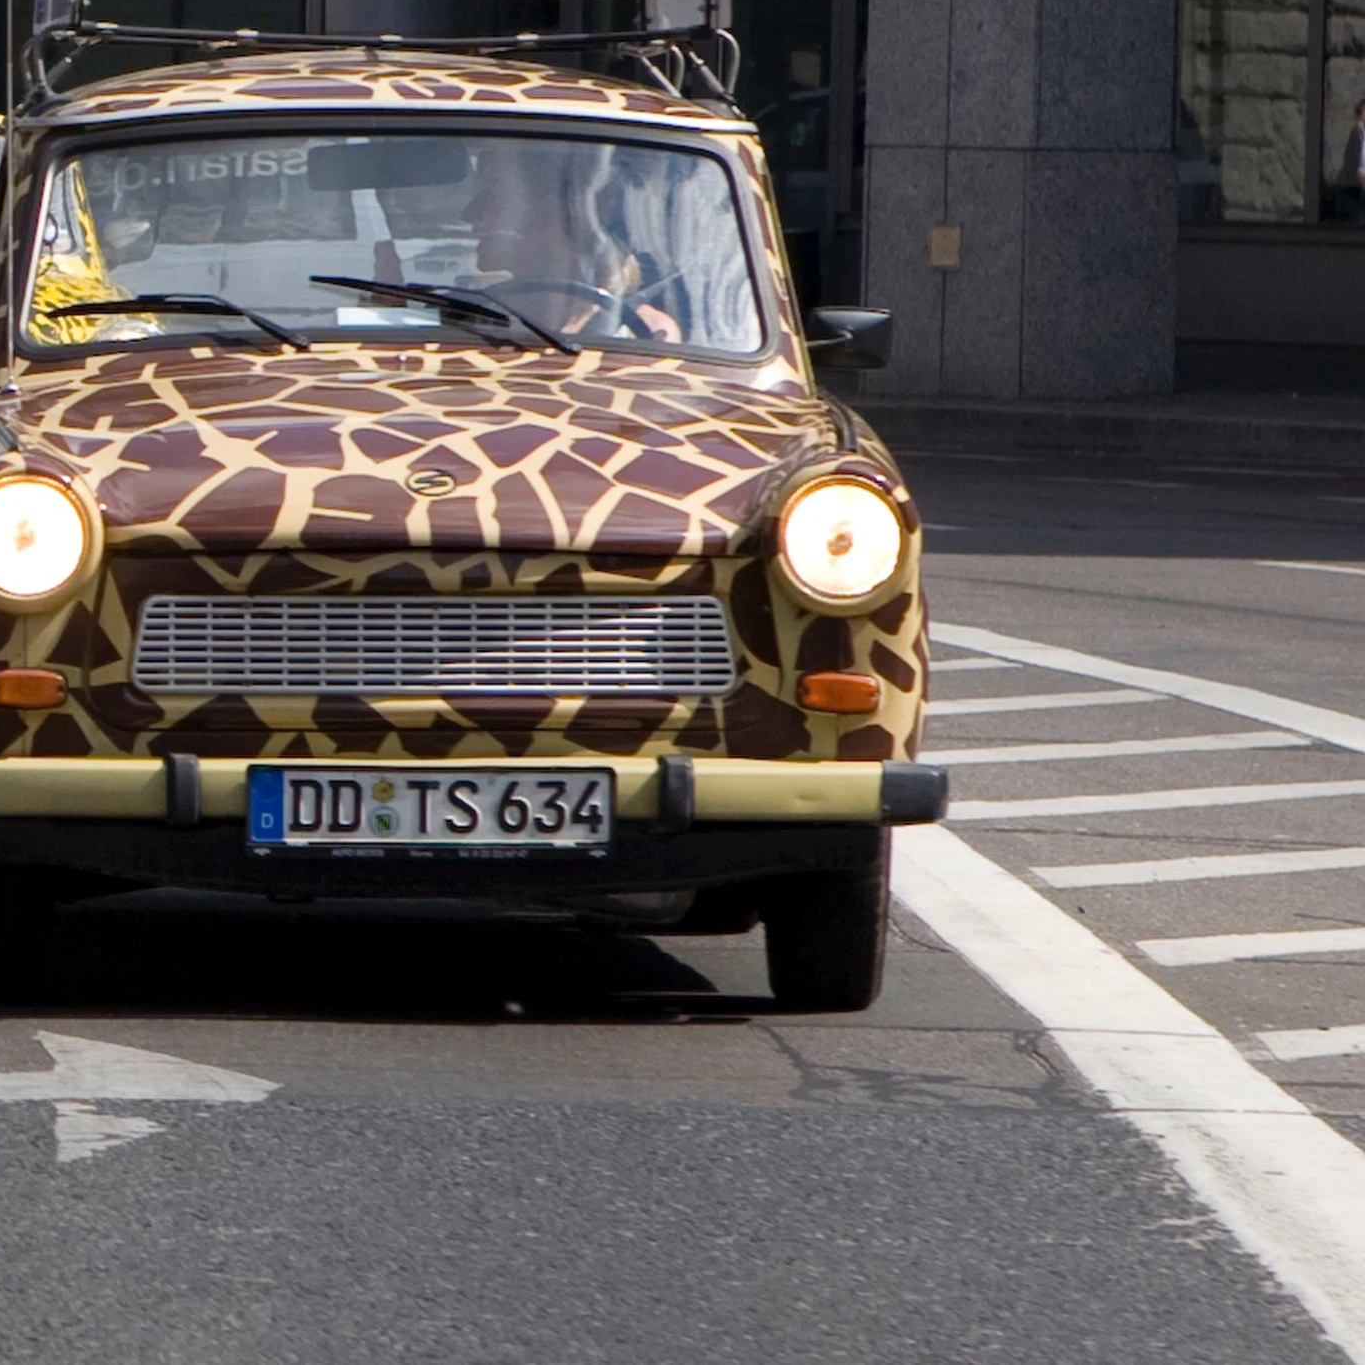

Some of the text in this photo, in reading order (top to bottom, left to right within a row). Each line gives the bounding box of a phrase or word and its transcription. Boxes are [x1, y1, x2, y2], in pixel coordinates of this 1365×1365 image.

[261, 779, 603, 834] D DD TS 634
